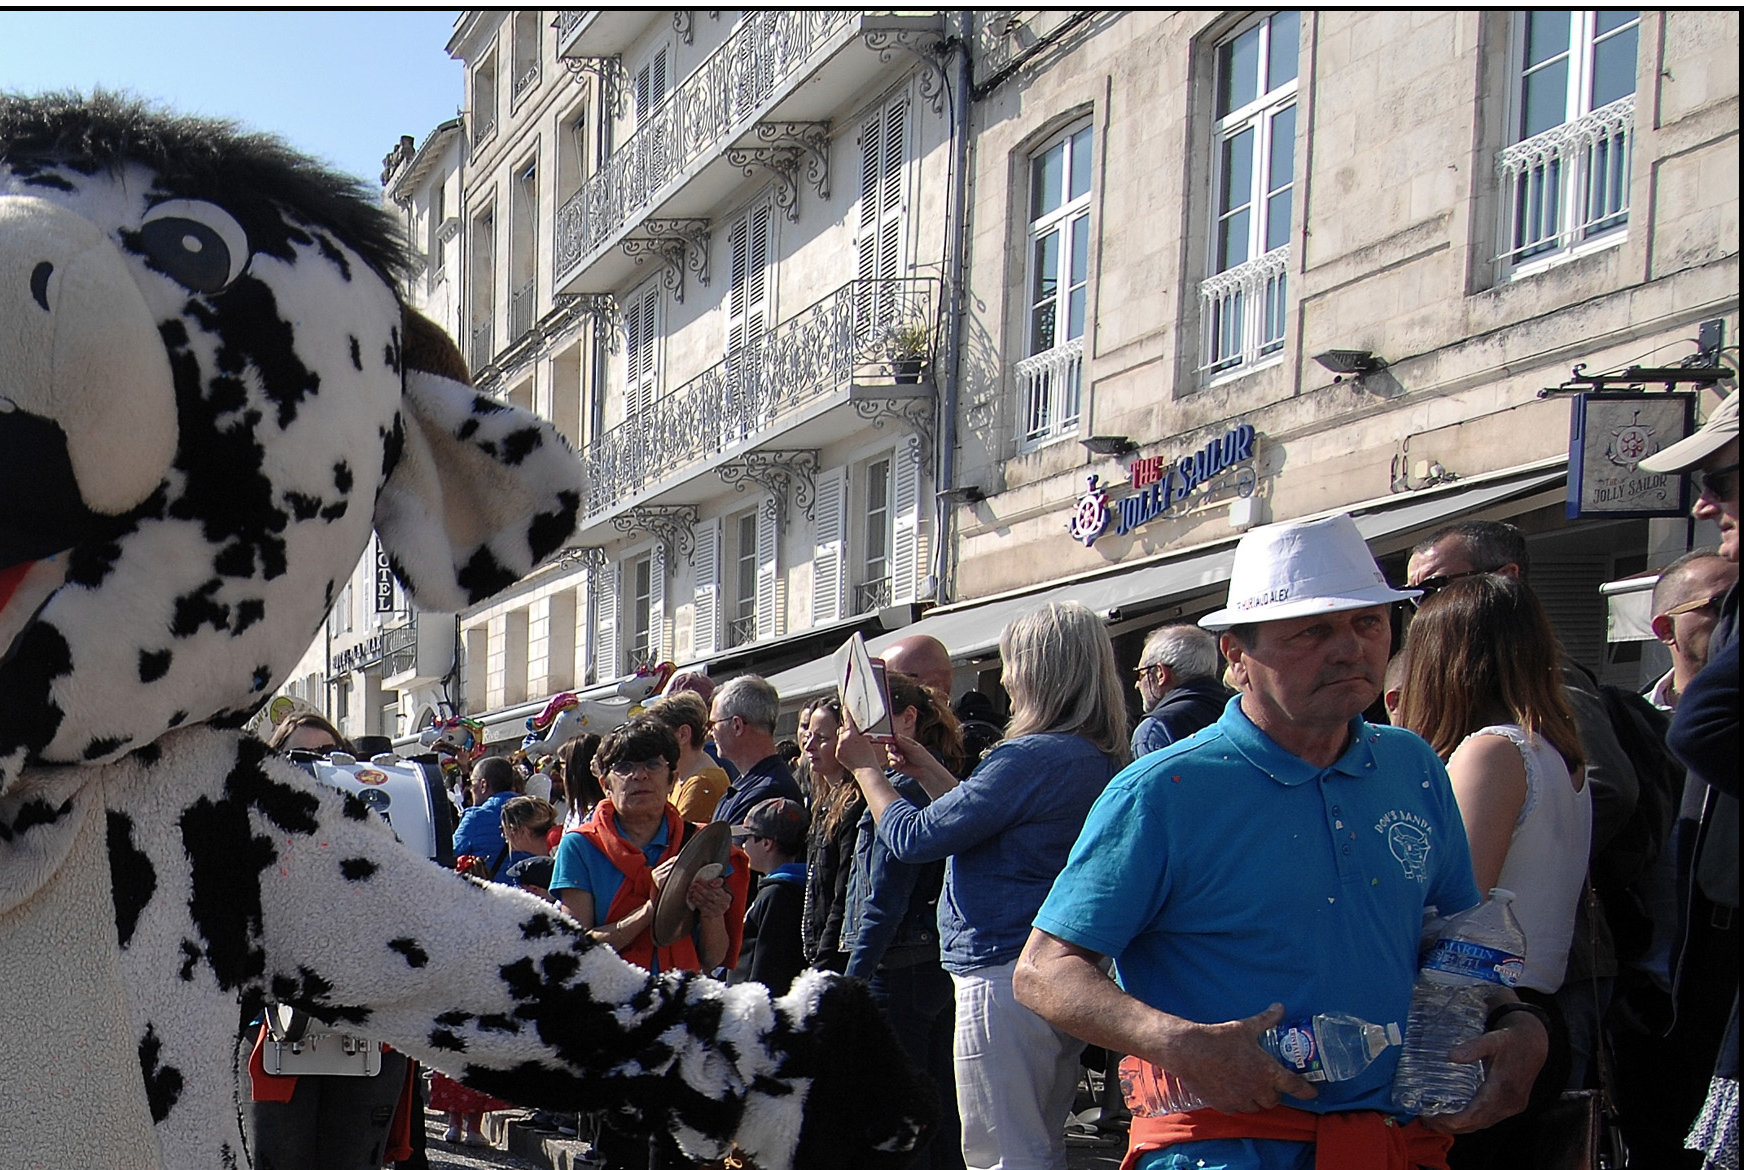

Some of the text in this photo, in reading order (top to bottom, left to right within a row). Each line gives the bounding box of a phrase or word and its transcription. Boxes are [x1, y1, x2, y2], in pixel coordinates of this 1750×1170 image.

[1116, 424, 1255, 536] JOLLY SAILOR
[1130, 456, 1163, 489] THE
[1593, 474, 1667, 503] JOLLY SAILOR
[1269, 588, 1289, 604] ALEX
[1444, 941, 1495, 960] MARTIN
